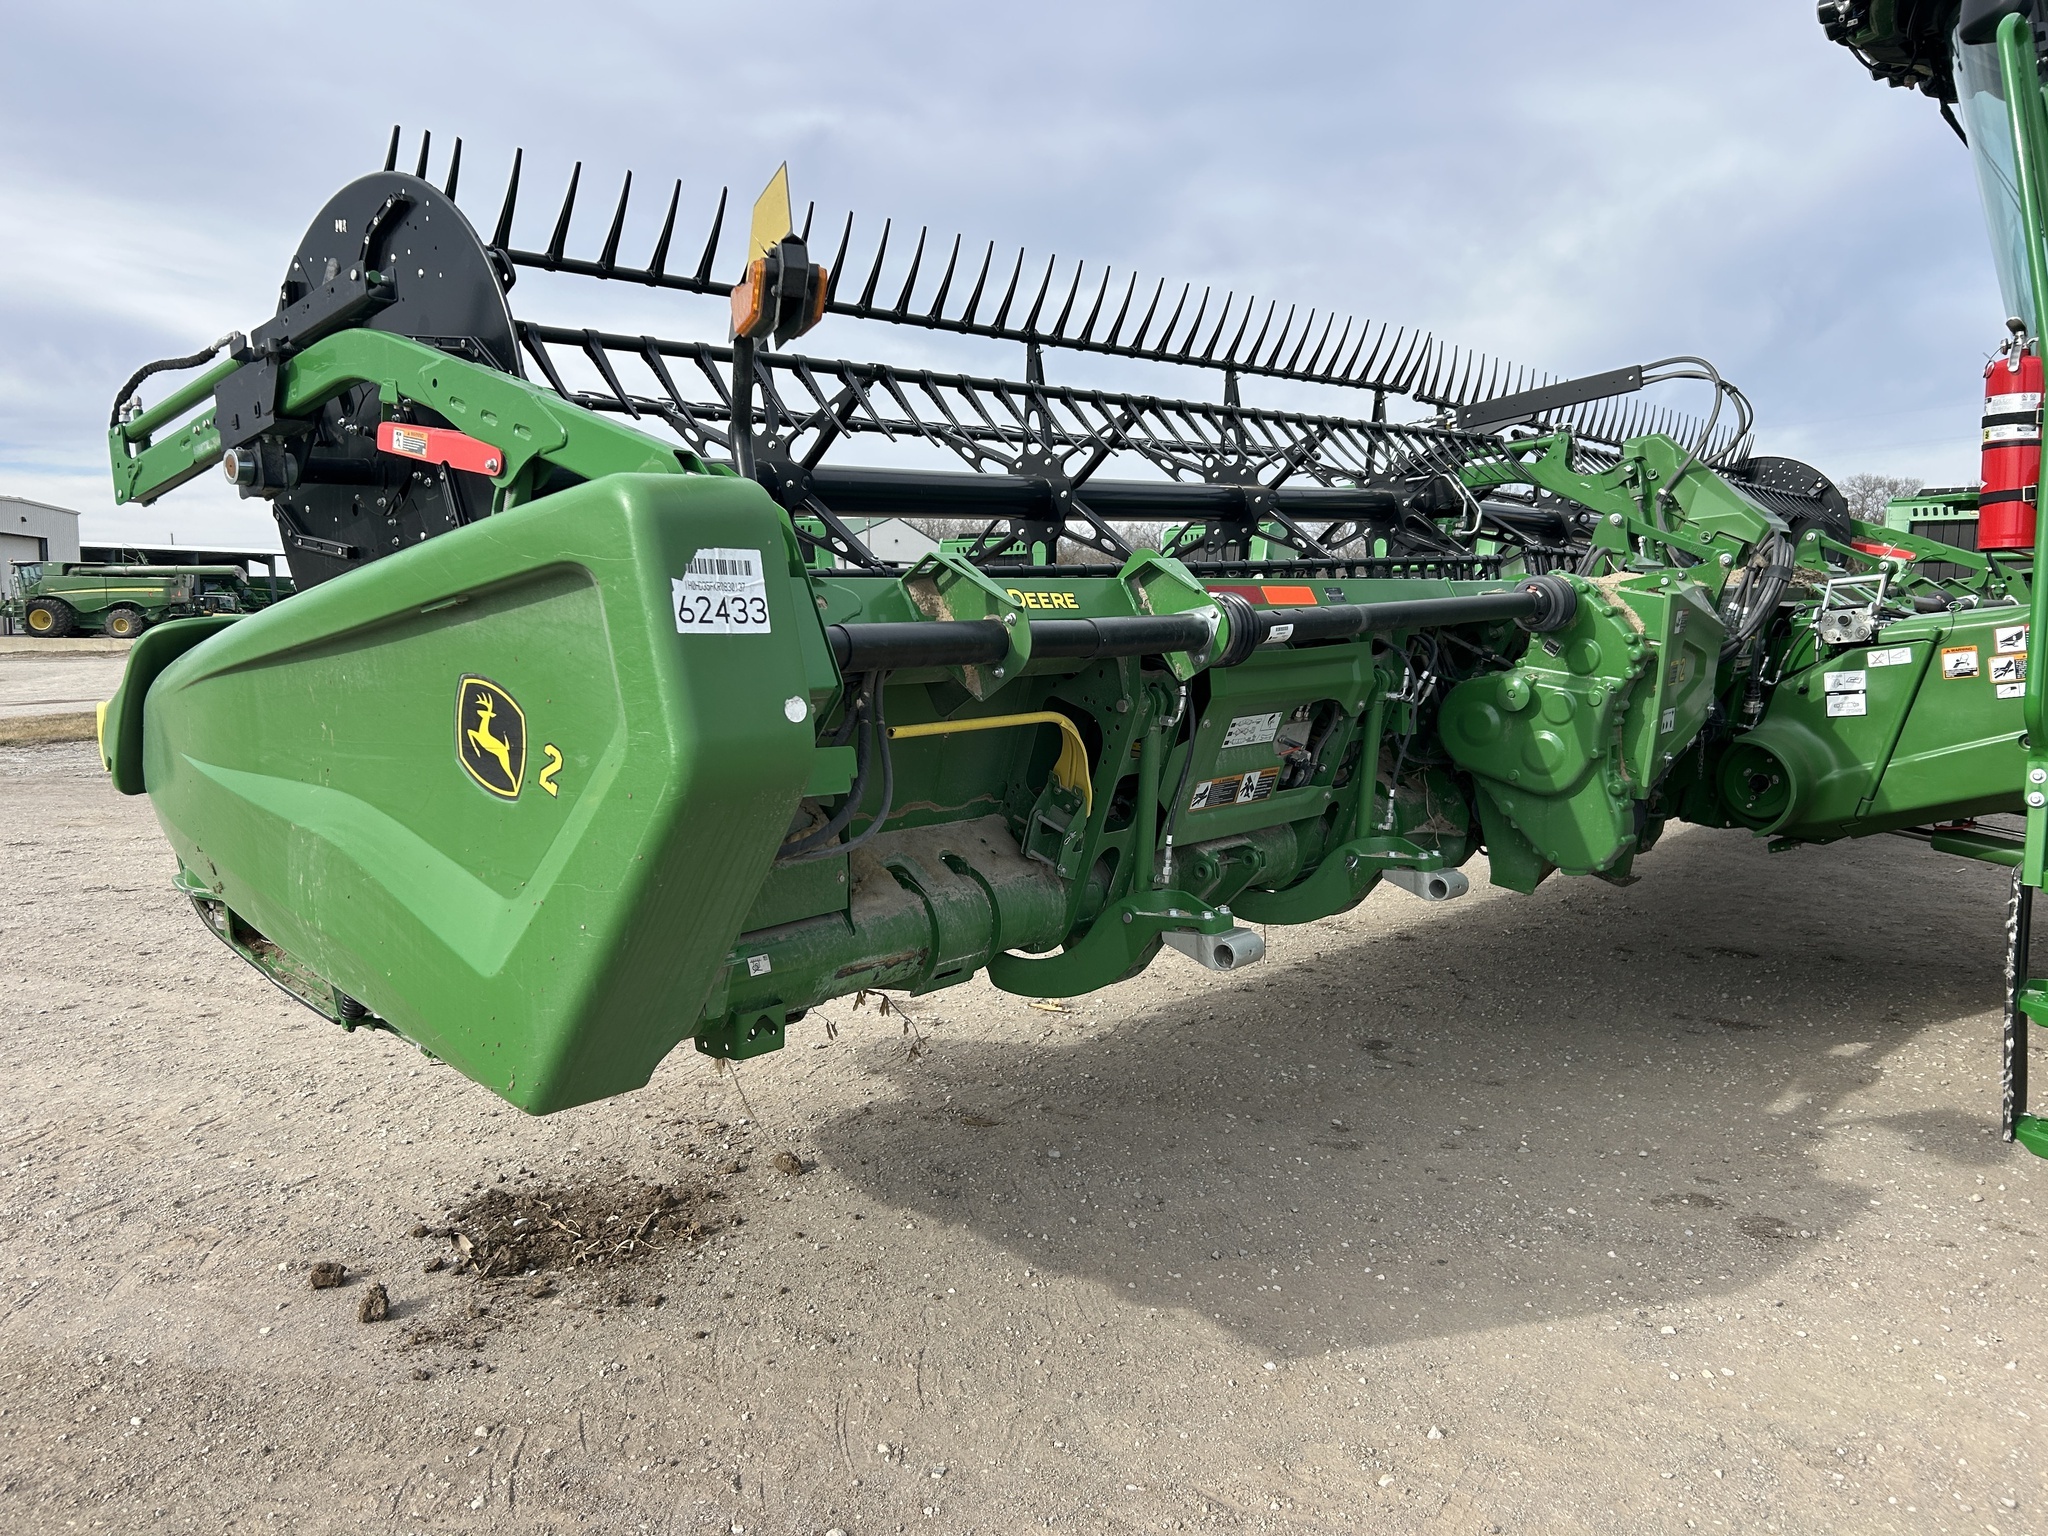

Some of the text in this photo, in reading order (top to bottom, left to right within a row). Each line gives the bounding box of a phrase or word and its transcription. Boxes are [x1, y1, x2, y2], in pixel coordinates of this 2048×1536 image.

[678, 595, 767, 624] 62433
[1006, 588, 1079, 609] DEERE
[539, 743, 563, 798] 2
